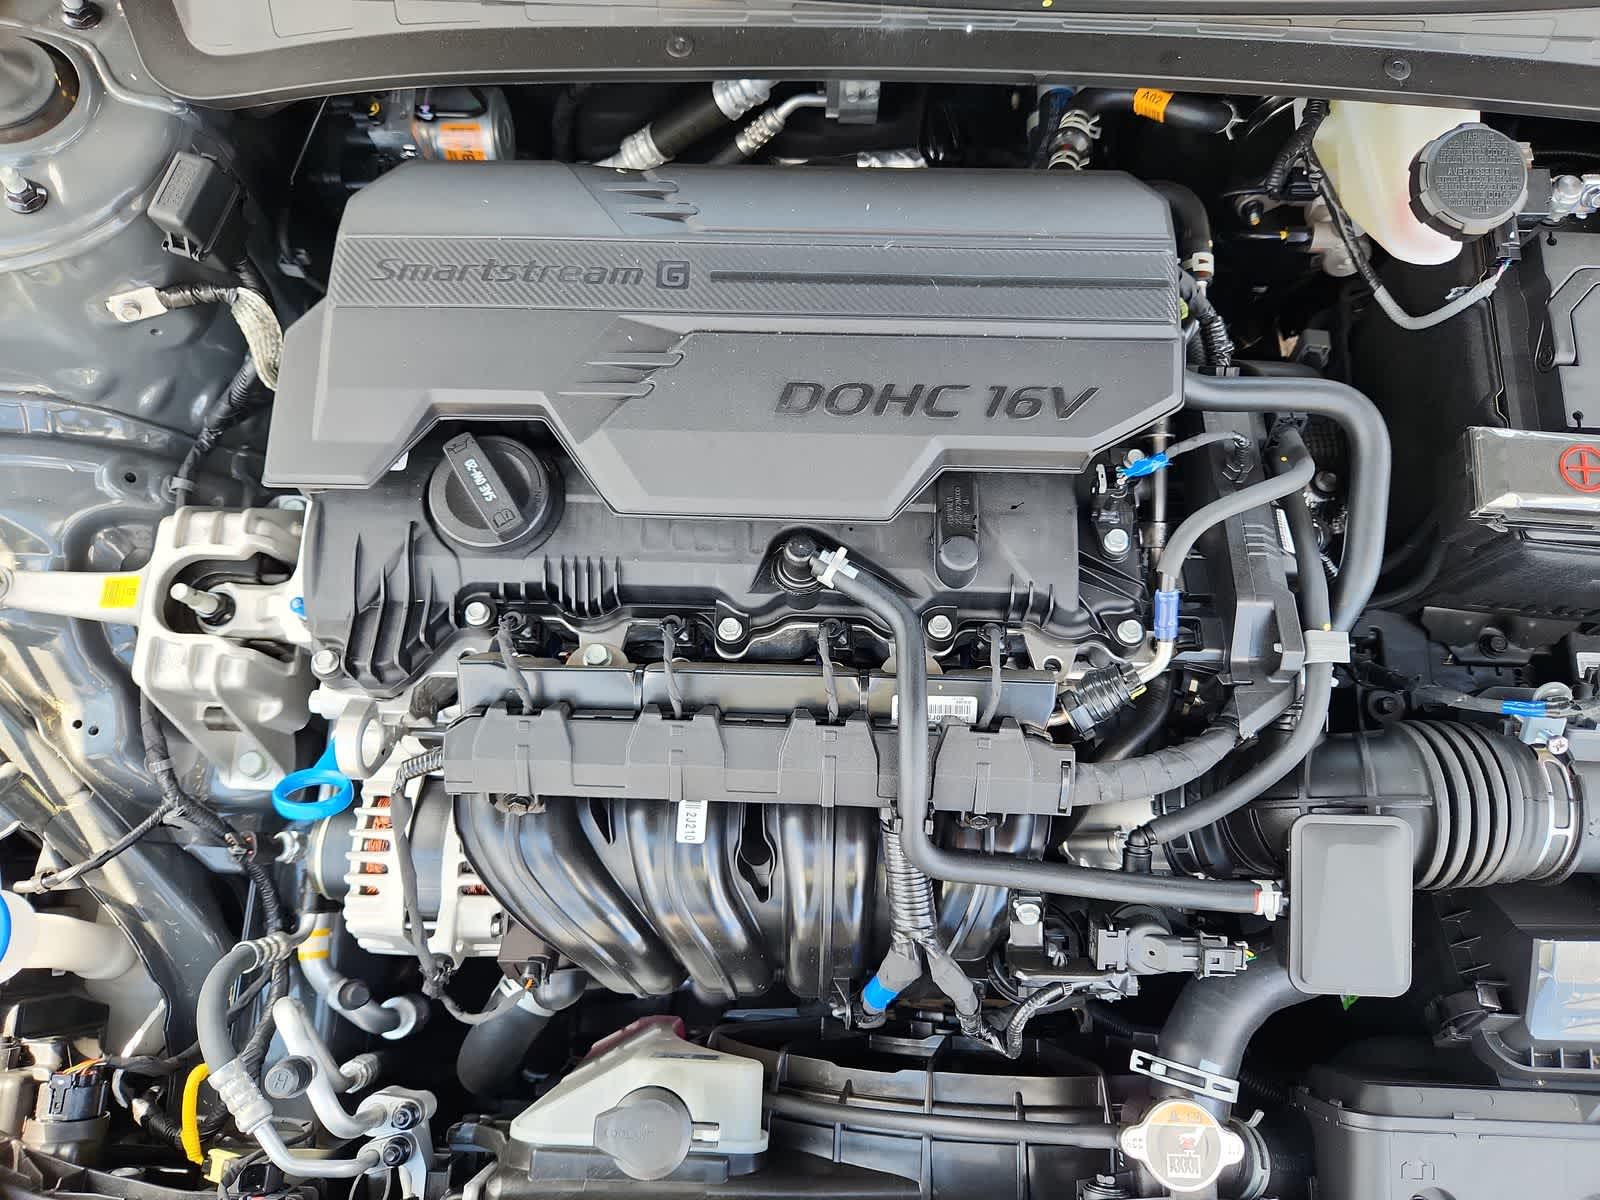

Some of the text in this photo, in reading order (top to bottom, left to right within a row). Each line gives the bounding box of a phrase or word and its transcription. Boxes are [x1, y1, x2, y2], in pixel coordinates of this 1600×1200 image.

[370, 257, 690, 289] Smartstream G
[774, 382, 1101, 420] DOHC 16V
[463, 458, 497, 502] SAE 0W-20
[684, 811, 697, 841] 2J210
